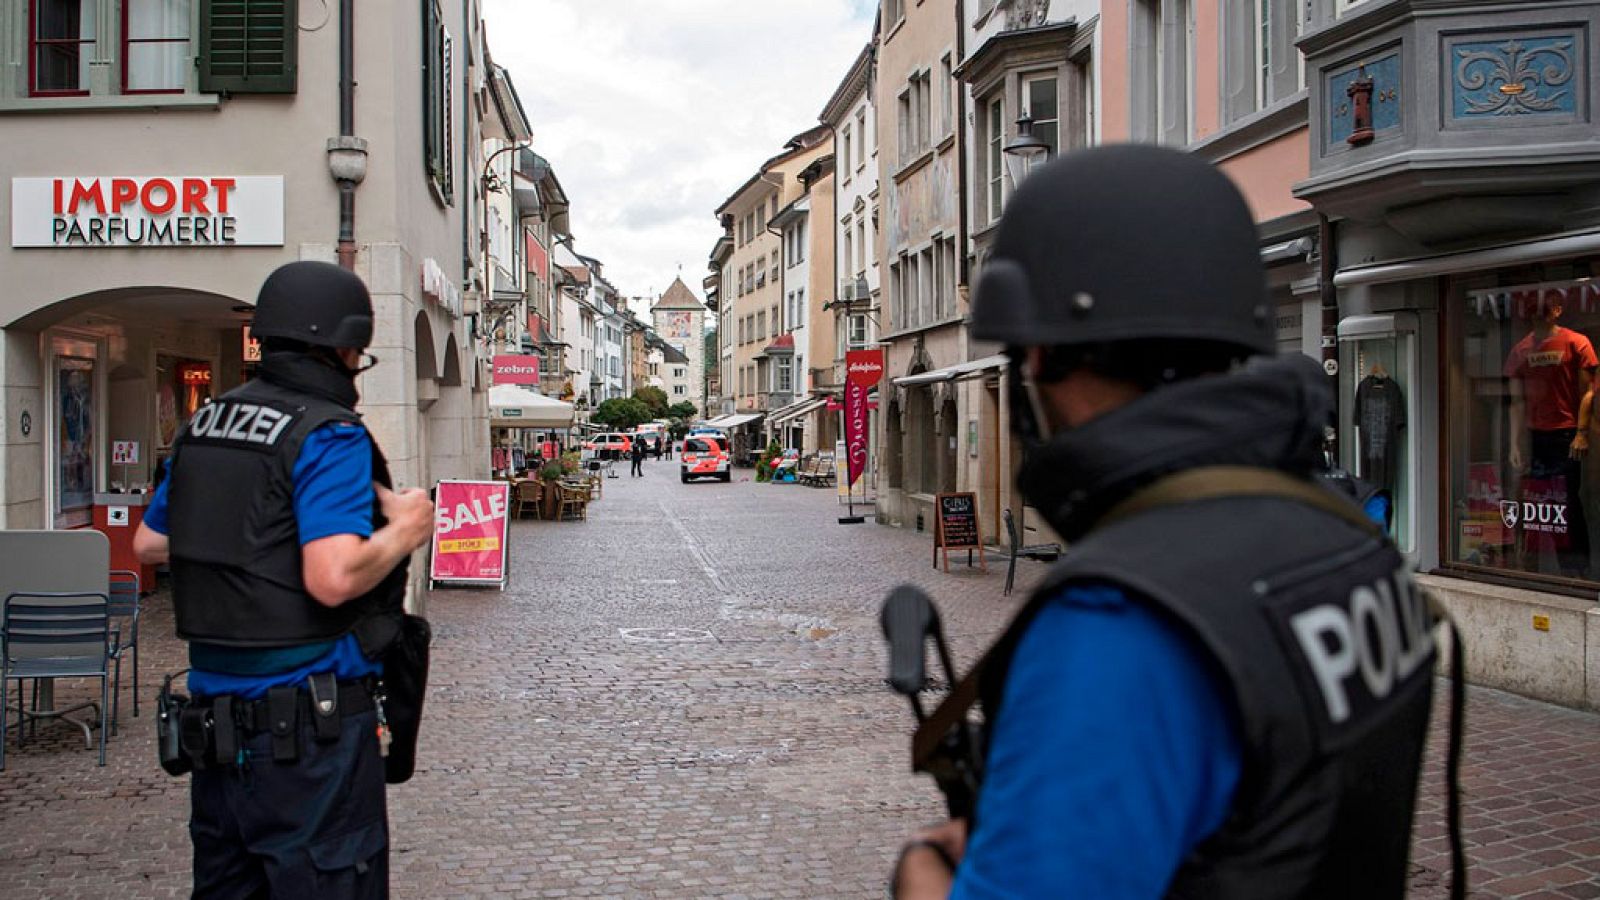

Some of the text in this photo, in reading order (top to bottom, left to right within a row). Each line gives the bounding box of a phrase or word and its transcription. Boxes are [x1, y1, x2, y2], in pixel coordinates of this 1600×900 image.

[53, 178, 236, 215] IMPORT
[53, 217, 236, 244] PARFUMERIE
[497, 365, 535, 374] zebra
[190, 402, 292, 445] OLIZEI
[436, 494, 505, 534] SALE
[1523, 502, 1568, 525] DUX
